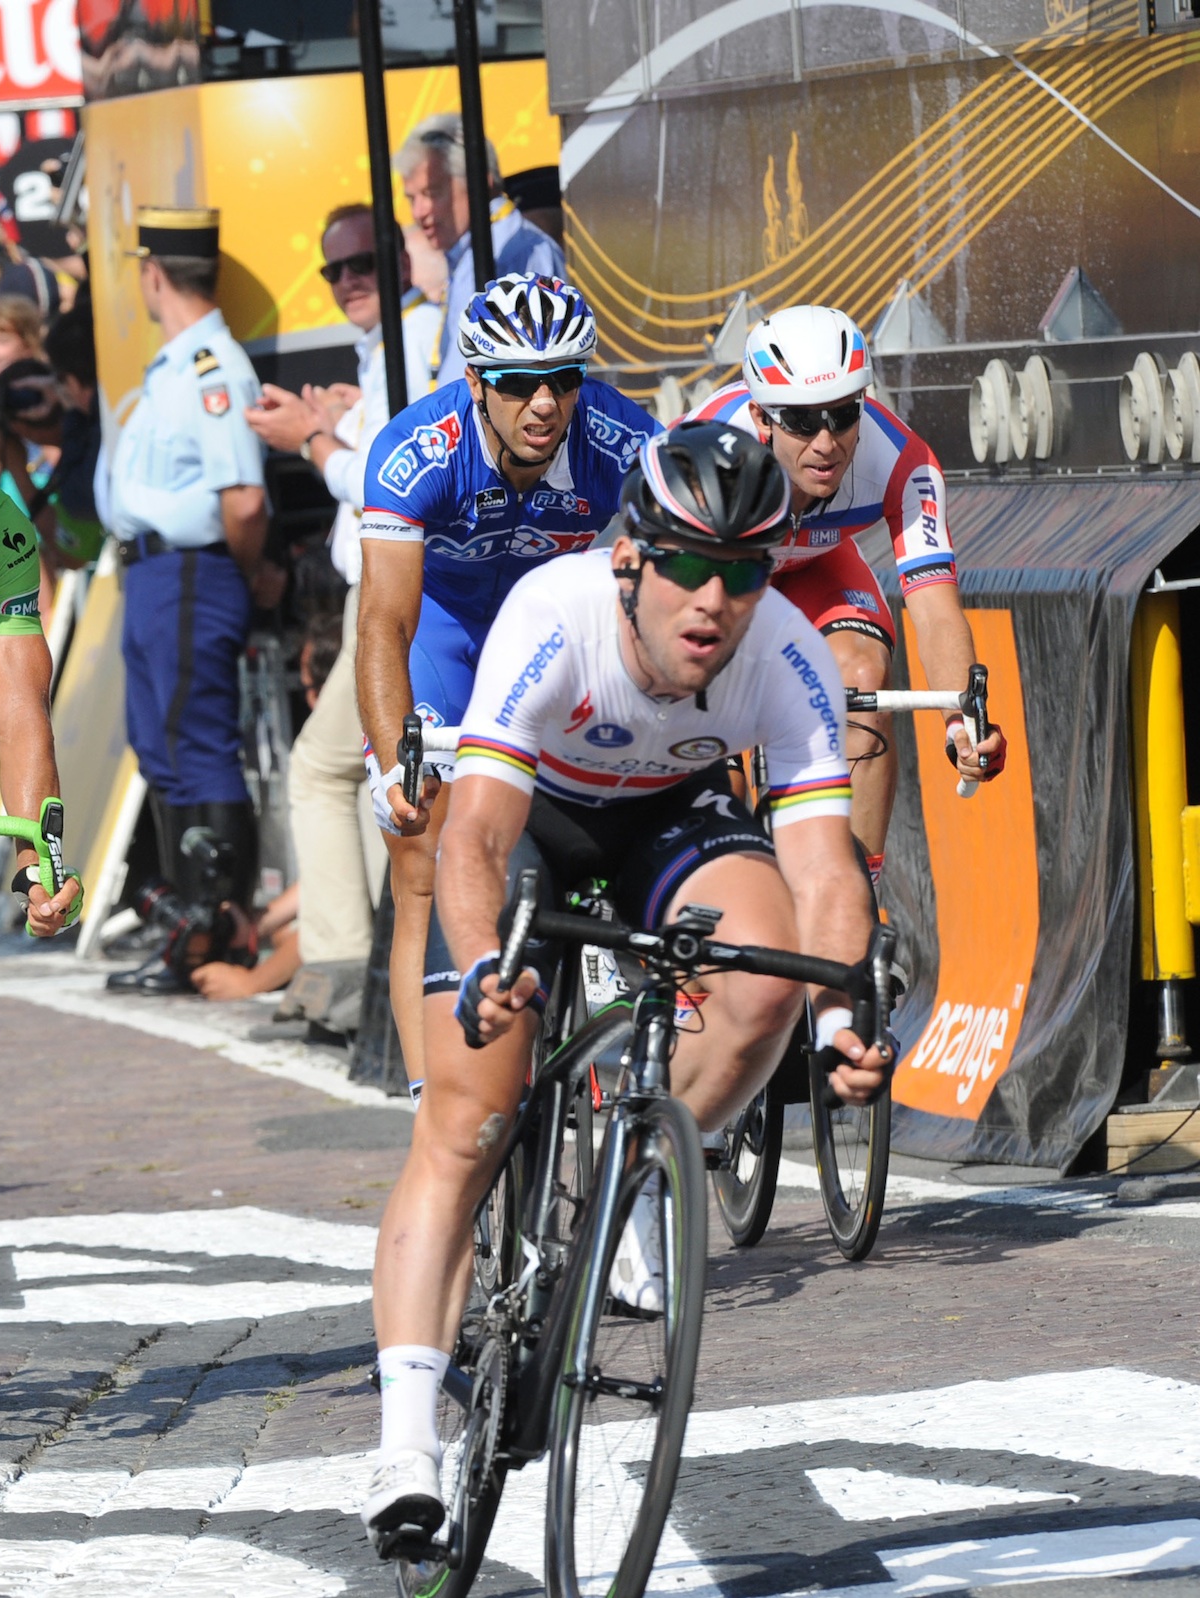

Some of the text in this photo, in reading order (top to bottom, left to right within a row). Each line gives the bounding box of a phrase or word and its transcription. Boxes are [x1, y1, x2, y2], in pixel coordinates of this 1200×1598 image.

[471, 331, 497, 354] uvex
[578, 326, 595, 349] uvex
[805, 371, 837, 385] GIRO
[589, 417, 622, 446] FDJ
[387, 448, 418, 487] FDJ
[911, 476, 939, 548] ITERA
[906, 568, 952, 583] CANYON
[831, 620, 883, 638] CANYON
[910, 1000, 1009, 1105] orange
